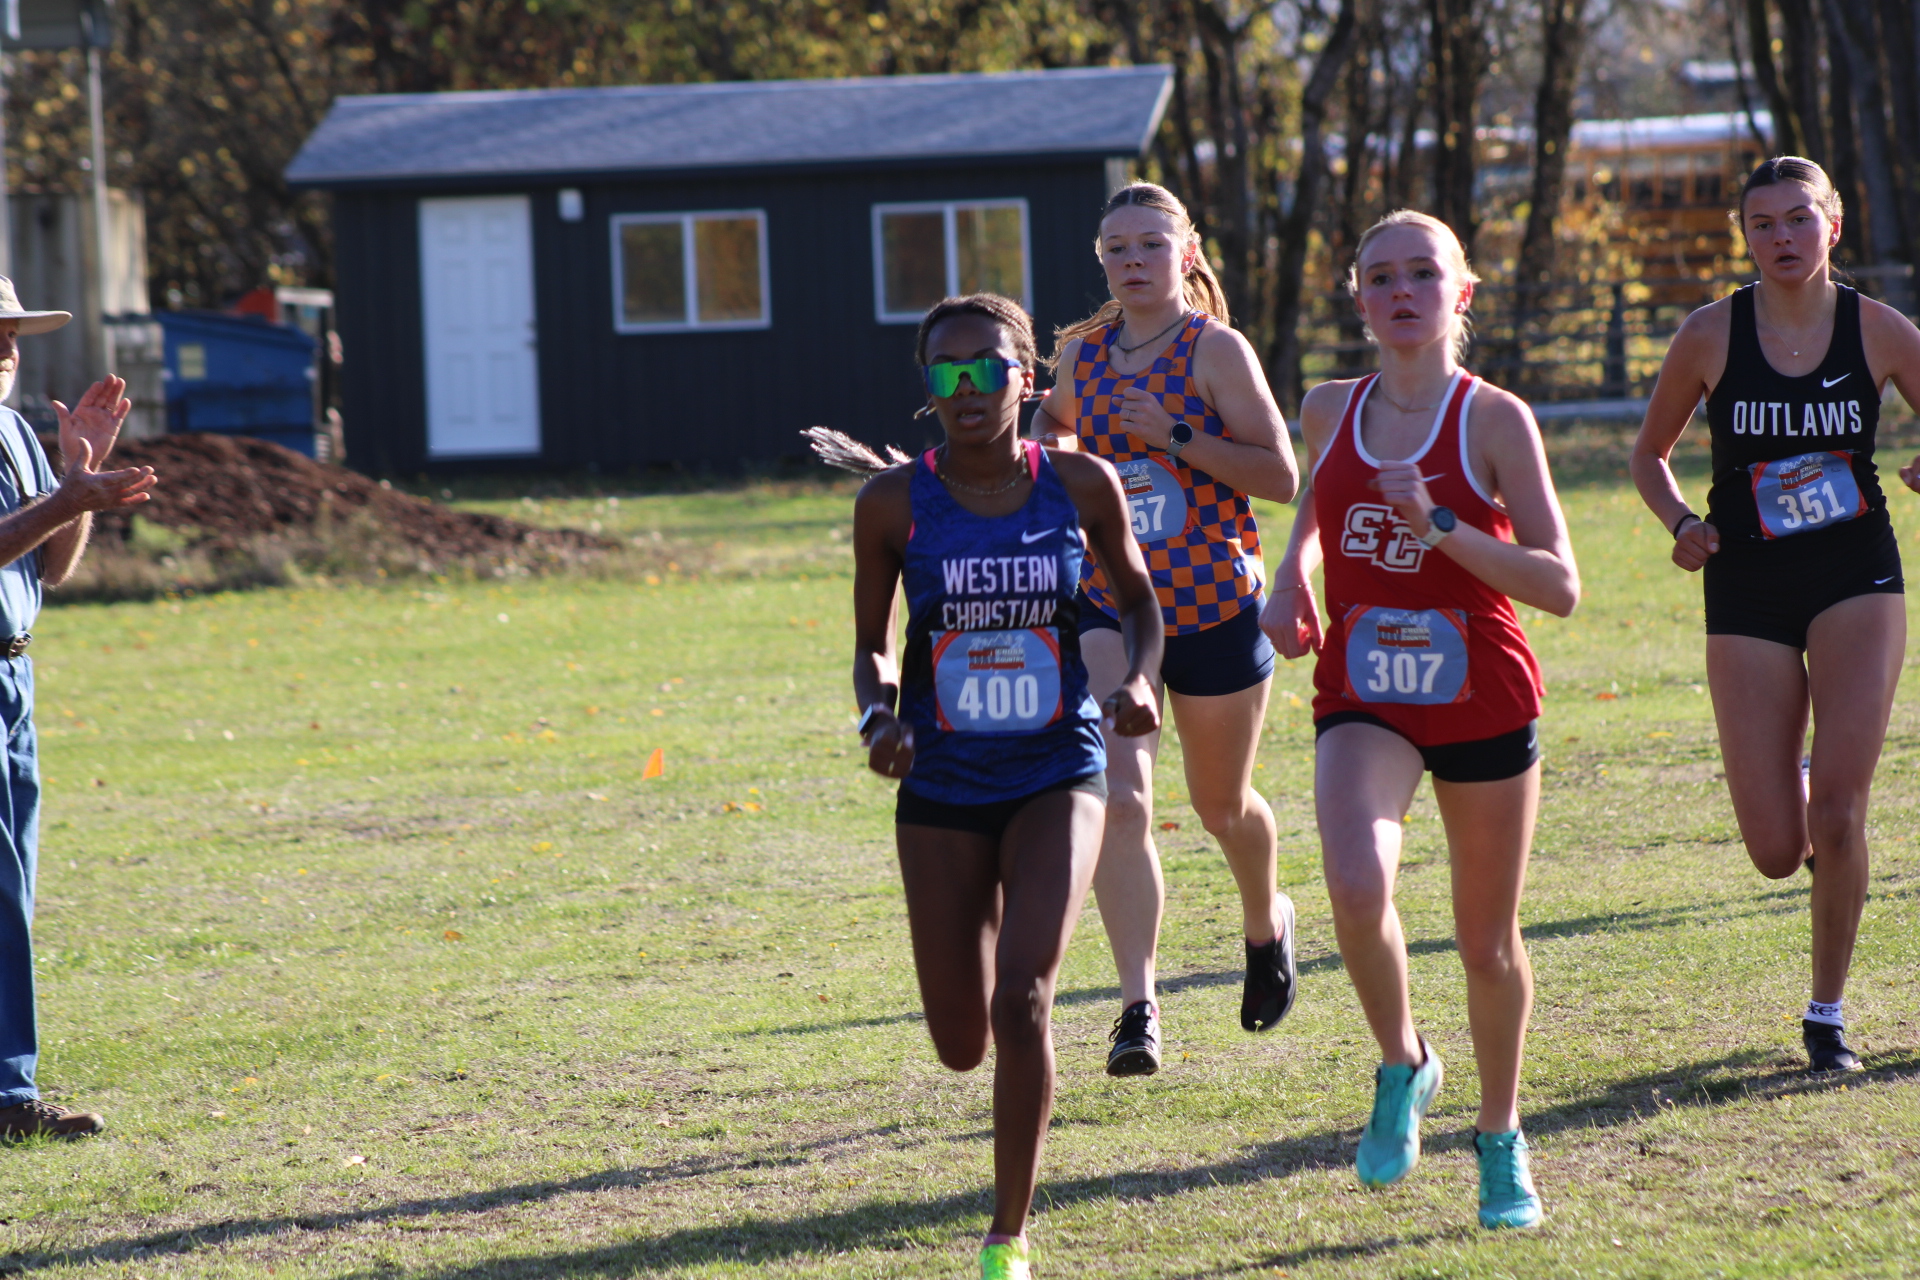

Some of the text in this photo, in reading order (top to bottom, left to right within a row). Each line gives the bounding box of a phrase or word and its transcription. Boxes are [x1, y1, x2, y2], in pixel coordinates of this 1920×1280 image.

[1733, 400, 1862, 436] OUTLAWS
[1777, 480, 1846, 529] 351
[942, 555, 1058, 595] WESTERN
[942, 599, 1057, 630] CHRISTIAN
[1367, 650, 1444, 694] 307
[957, 674, 1039, 720] 400
